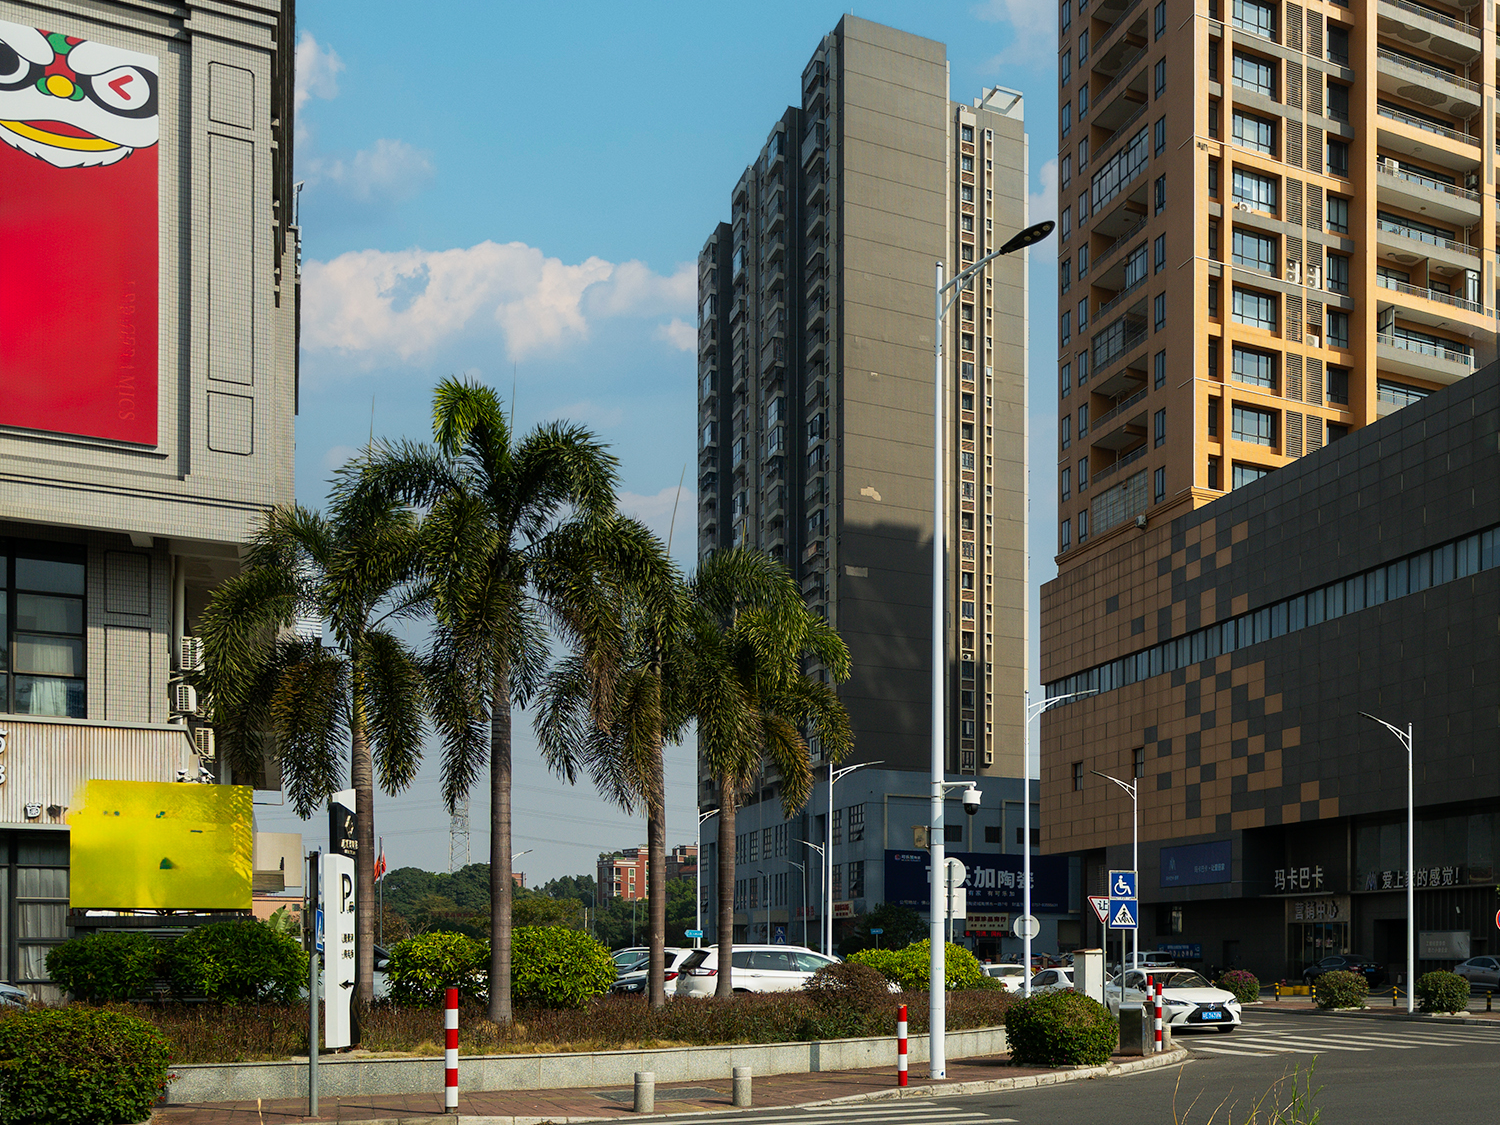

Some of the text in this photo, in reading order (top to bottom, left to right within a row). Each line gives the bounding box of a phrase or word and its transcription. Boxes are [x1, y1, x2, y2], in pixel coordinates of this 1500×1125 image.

[1274, 865, 1324, 890] 玛卡巴卡
[339, 873, 352, 914] P
[1097, 900, 1109, 911] 让
[1295, 900, 1339, 920] 营销中心
